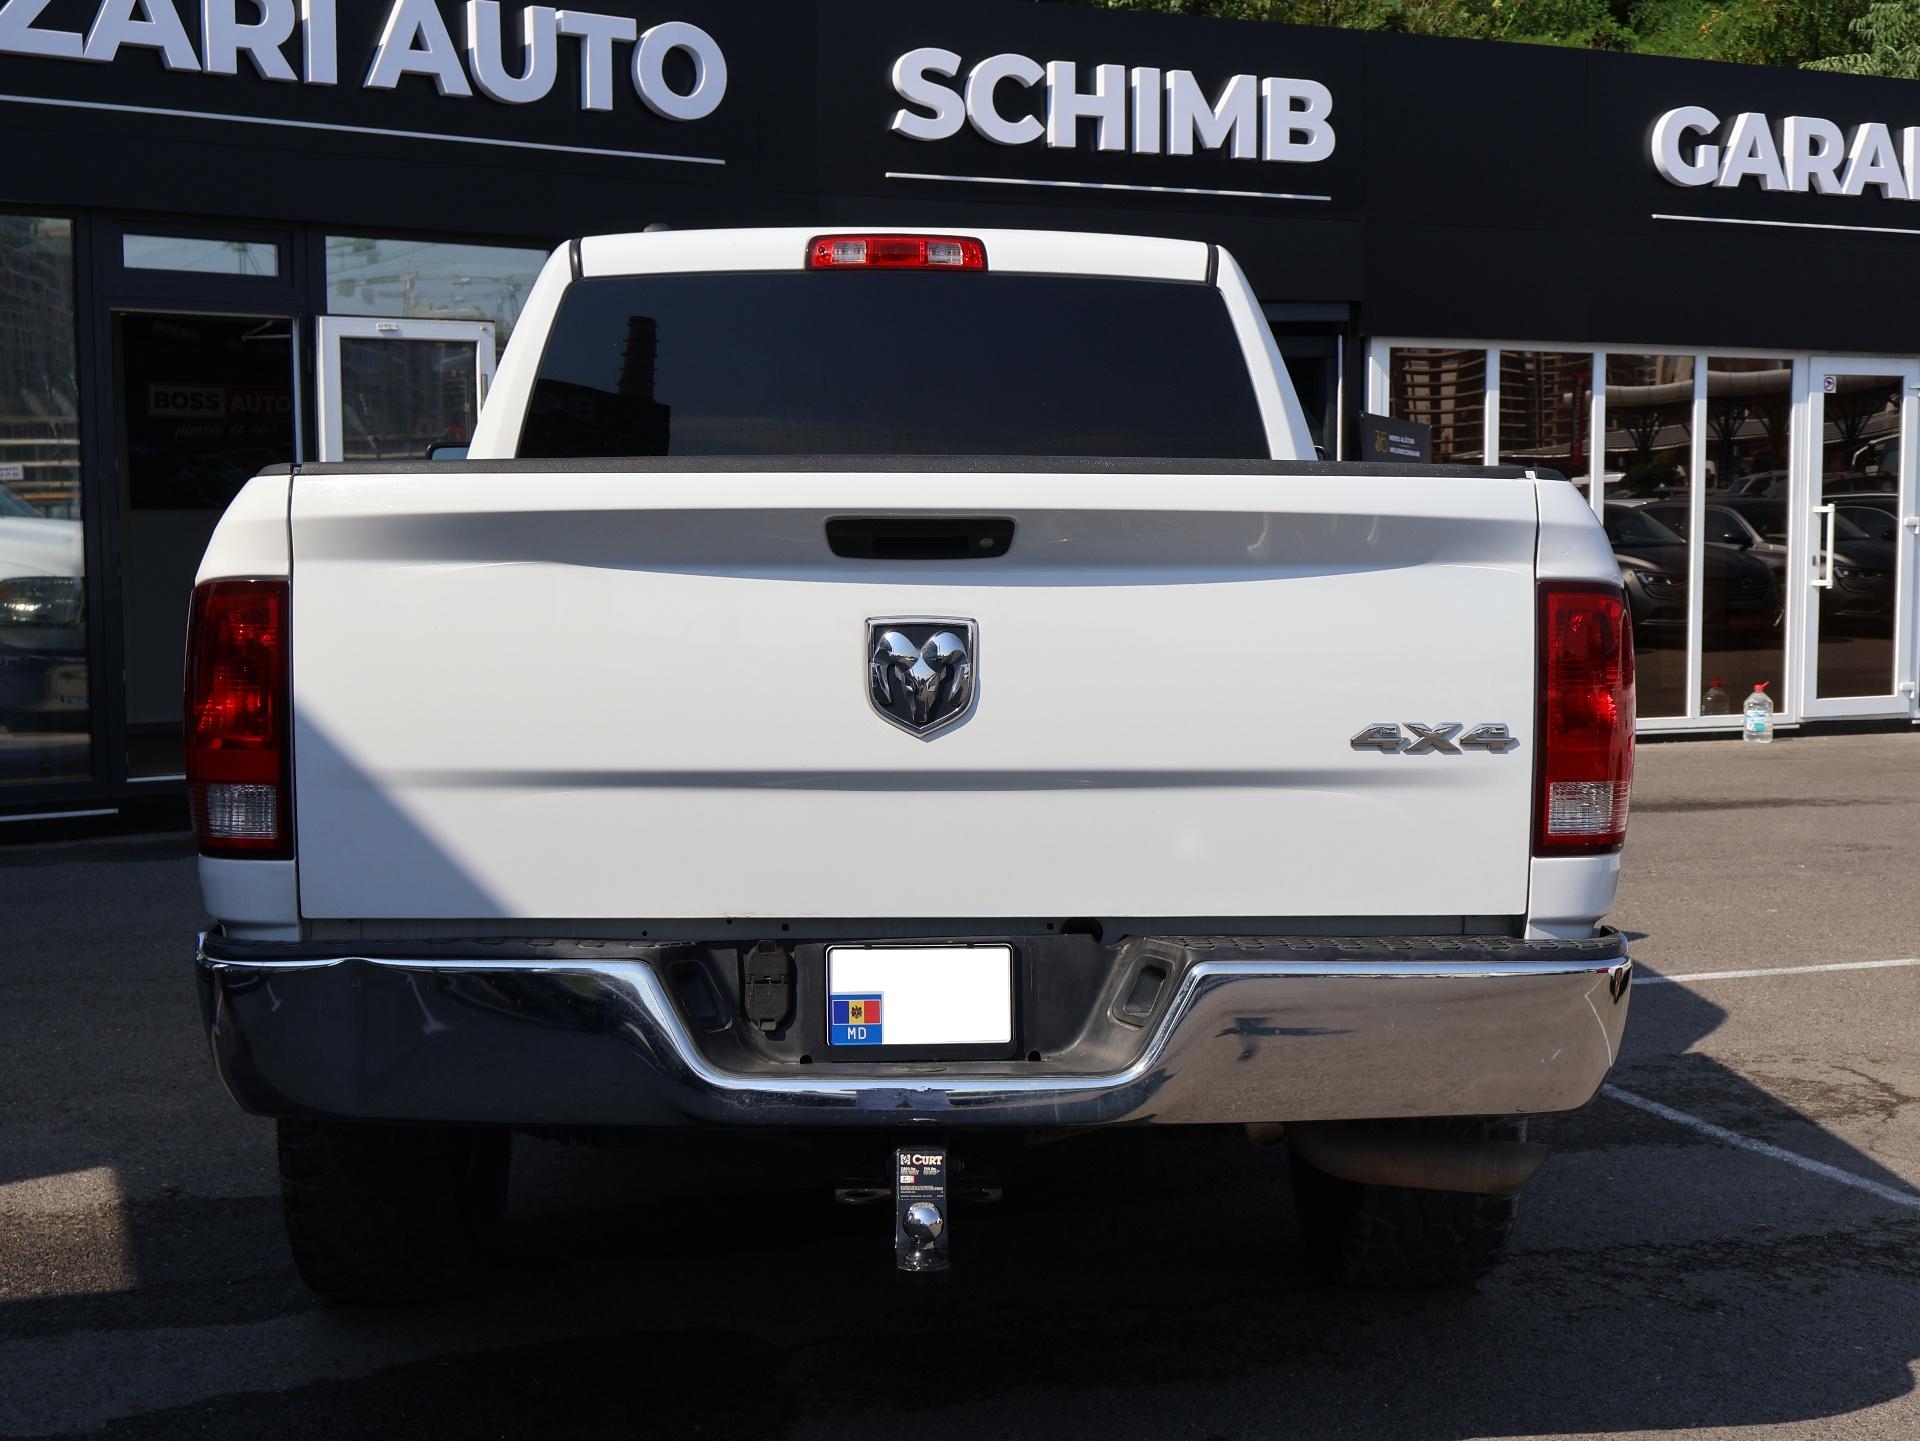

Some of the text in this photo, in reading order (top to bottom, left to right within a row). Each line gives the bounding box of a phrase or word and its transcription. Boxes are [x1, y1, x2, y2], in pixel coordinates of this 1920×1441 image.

[363, 0, 728, 121] AUTO
[891, 47, 1336, 163] SCHIMB
[154, 390, 291, 414] BOSS AUTO
[1350, 722, 1518, 754] 4X4
[847, 1026, 867, 1040] MD
[912, 1154, 943, 1166] CURT
